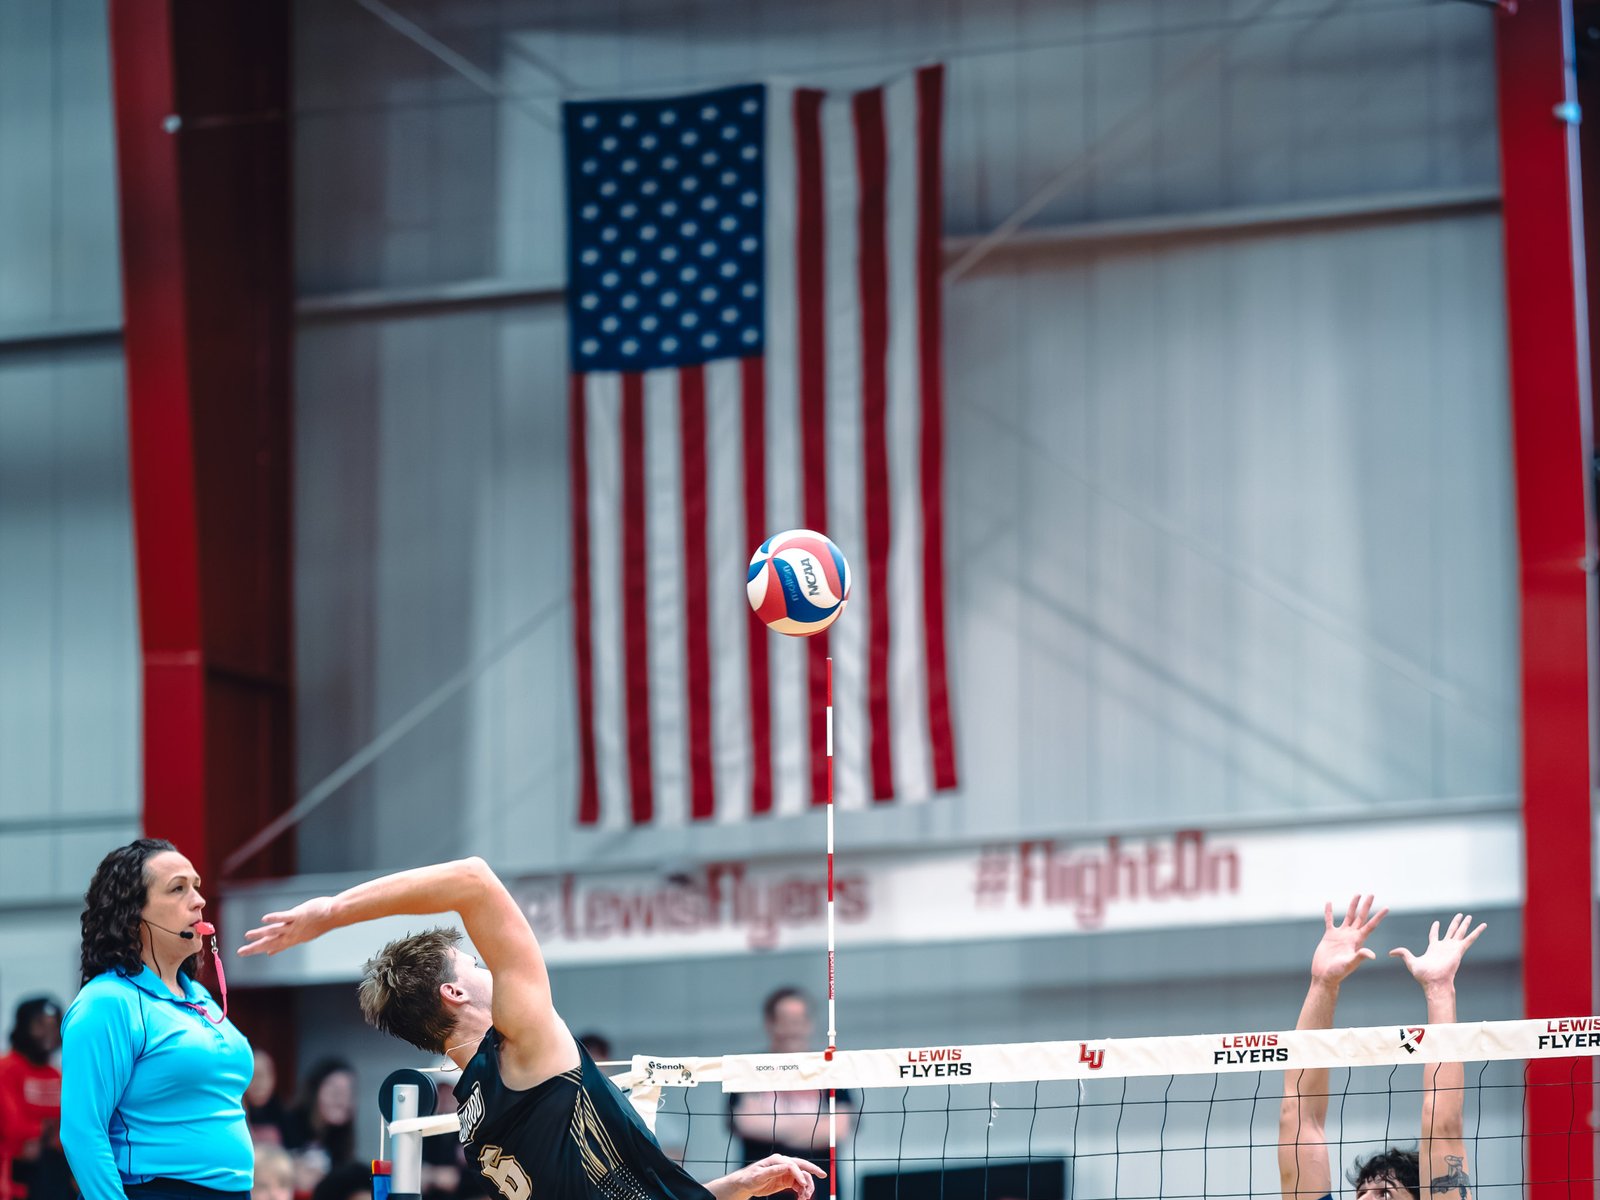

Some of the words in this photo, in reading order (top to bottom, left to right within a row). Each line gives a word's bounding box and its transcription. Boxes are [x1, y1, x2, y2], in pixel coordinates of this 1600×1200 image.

[801, 558, 820, 596] NCAA
[1547, 1018, 1600, 1033] LEWIS
[1222, 1034, 1278, 1049] LEWIS
[1537, 1033, 1600, 1049] FLYER
[907, 1049, 962, 1063] LEWIS
[1079, 1043, 1105, 1070] LU
[1213, 1047, 1289, 1065] FLYERS
[656, 1062, 685, 1071] Senoh
[755, 1064, 775, 1072] sports
[776, 1063, 799, 1072] mports
[899, 1062, 972, 1078] FLYERS
